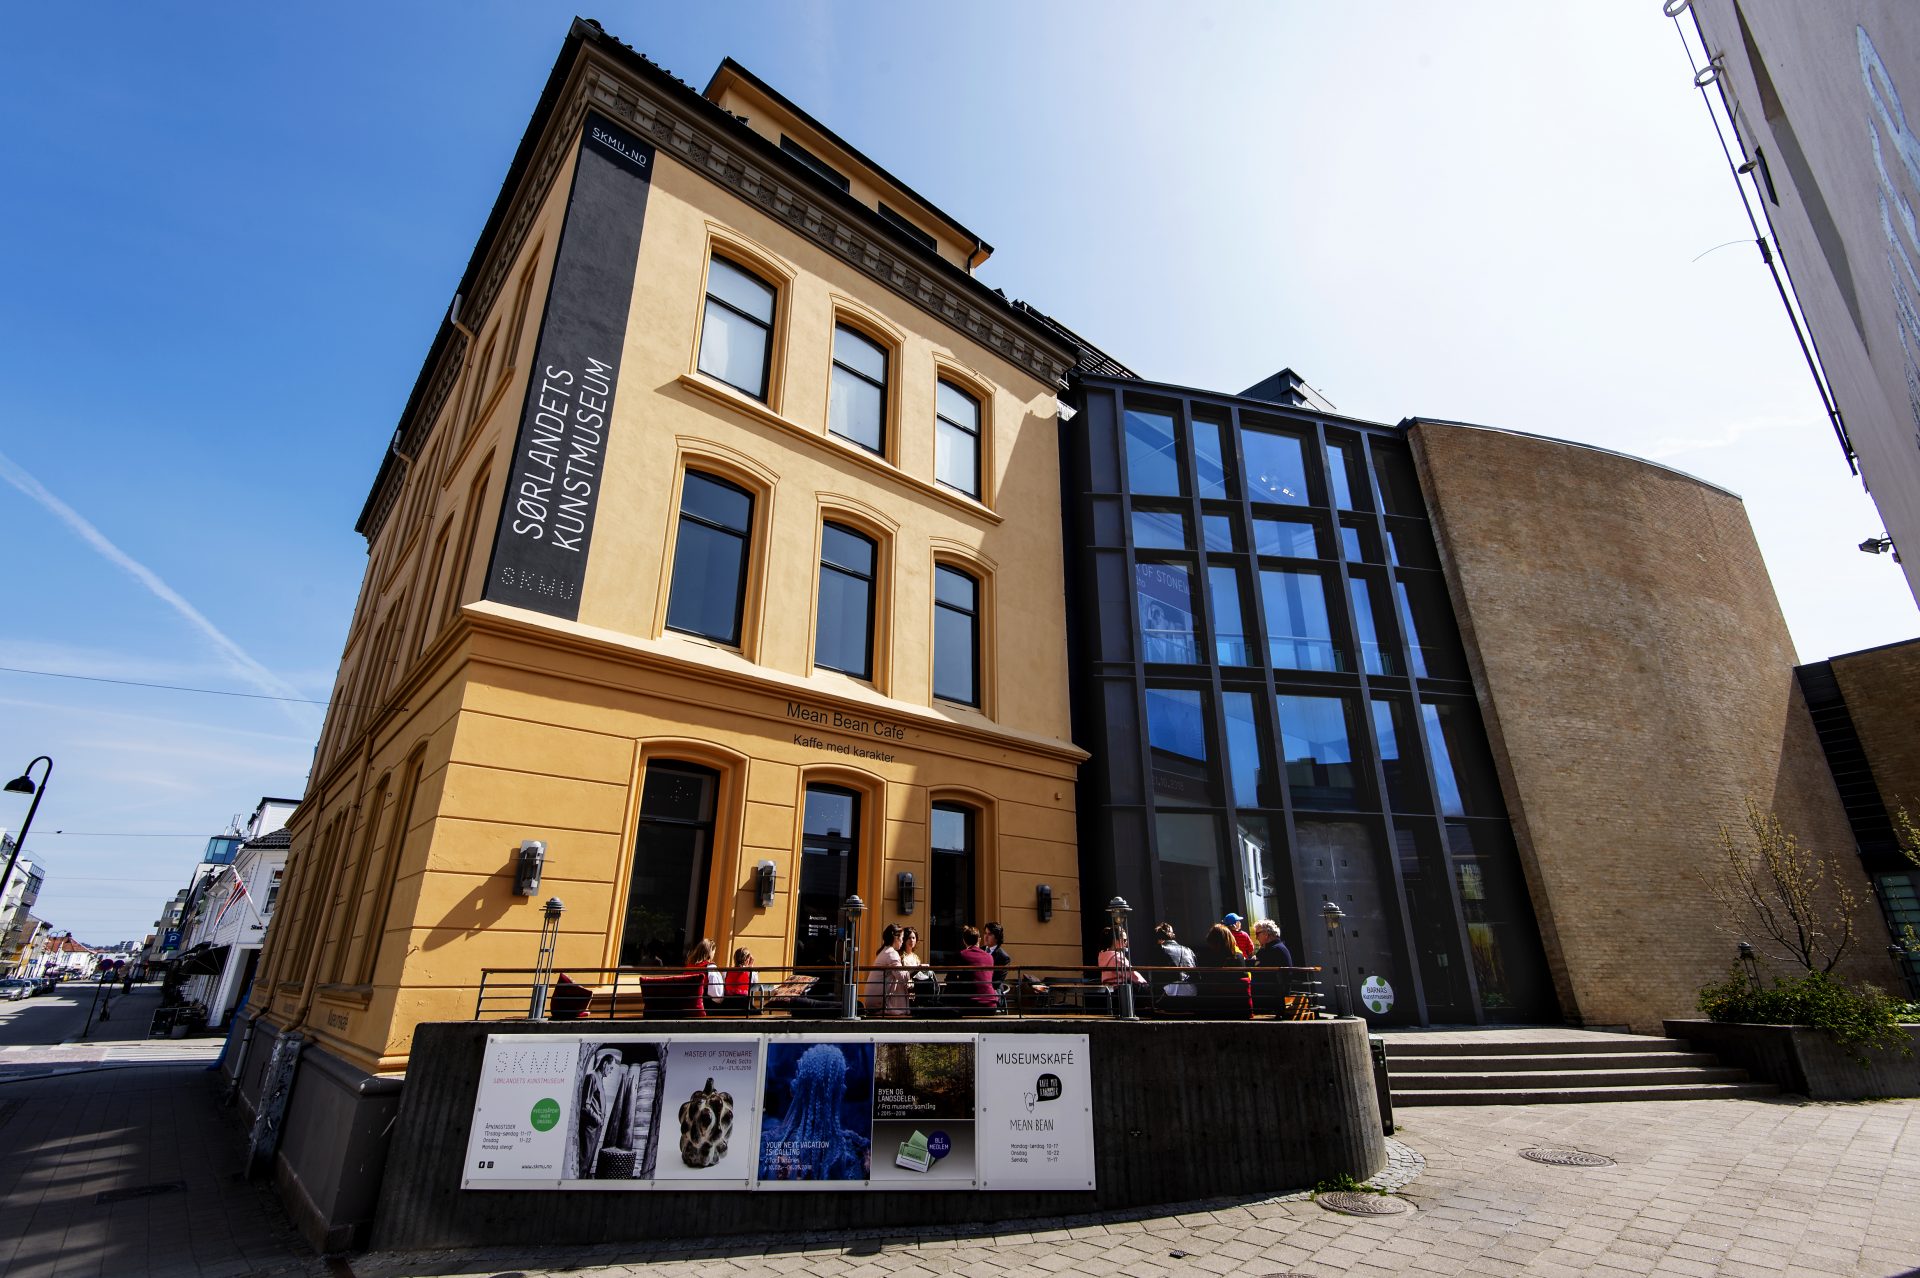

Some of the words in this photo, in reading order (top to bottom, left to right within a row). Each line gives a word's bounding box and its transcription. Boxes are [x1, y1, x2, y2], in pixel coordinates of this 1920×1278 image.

[592, 127, 647, 165] SKMU.NO
[513, 365, 573, 539] SØRLANDETS
[552, 356, 612, 552] KUNSTMUSEUM
[501, 567, 575, 600] SKMU
[787, 702, 828, 725] Mean
[833, 712, 869, 733] Bean
[794, 734, 823, 749] Kaffe
[826, 743, 850, 755] med
[853, 746, 894, 763] karakter
[496, 1051, 570, 1073] SKMU
[996, 1050, 1074, 1065] MUSEUMSKAFÉ
[914, 1102, 936, 1110] samling
[1010, 1119, 1033, 1131] MEAN
[1035, 1119, 1054, 1131] BEAN
[766, 1141, 782, 1149] YOUR
[784, 1141, 799, 1149] NEXT
[800, 1141, 830, 1149] VACATION
